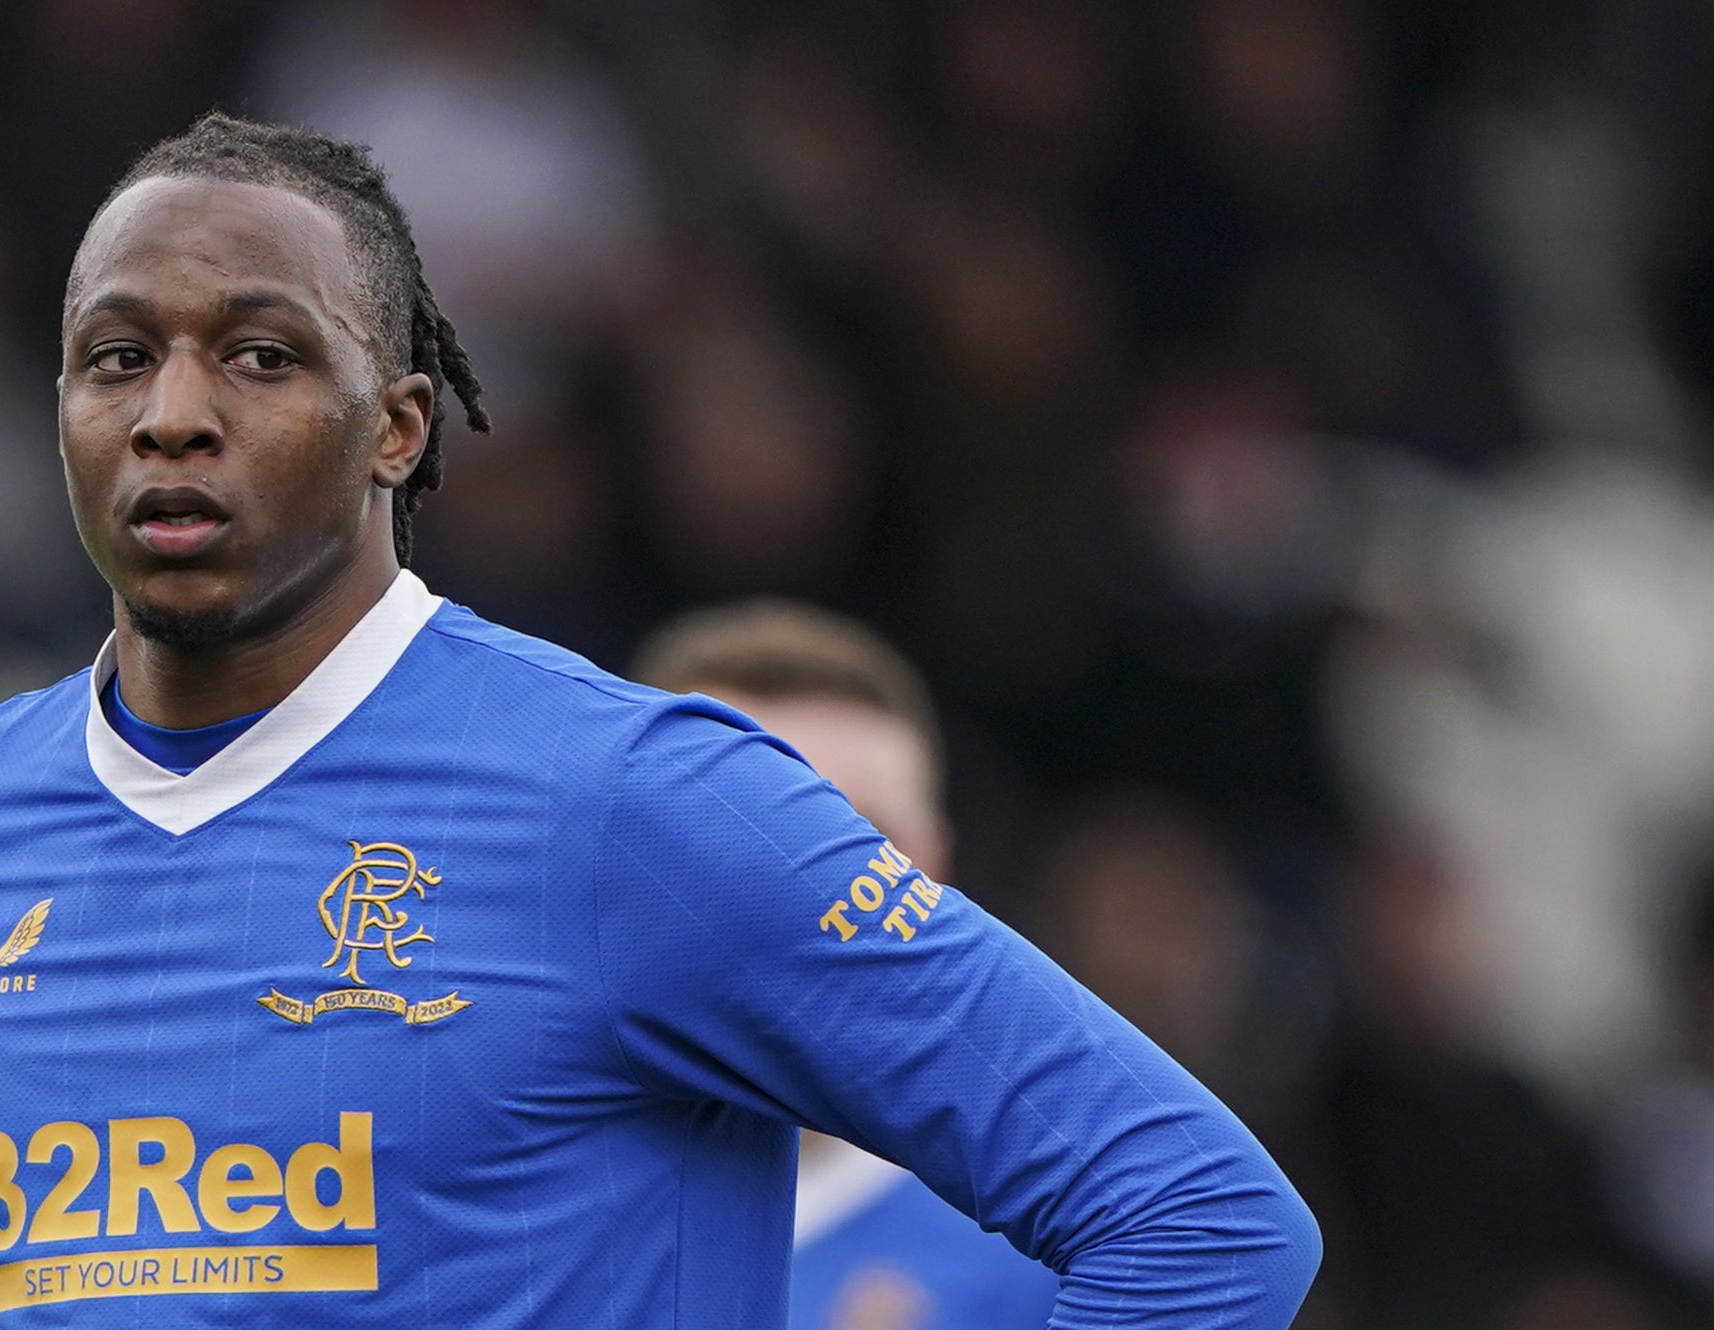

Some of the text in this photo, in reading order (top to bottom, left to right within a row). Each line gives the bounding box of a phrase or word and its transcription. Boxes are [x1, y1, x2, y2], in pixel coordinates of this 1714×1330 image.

[345, 990, 396, 1009] YEARS
[420, 1000, 453, 1018] 2022
[24, 1255, 285, 1296] SET YOUR LIMITS
